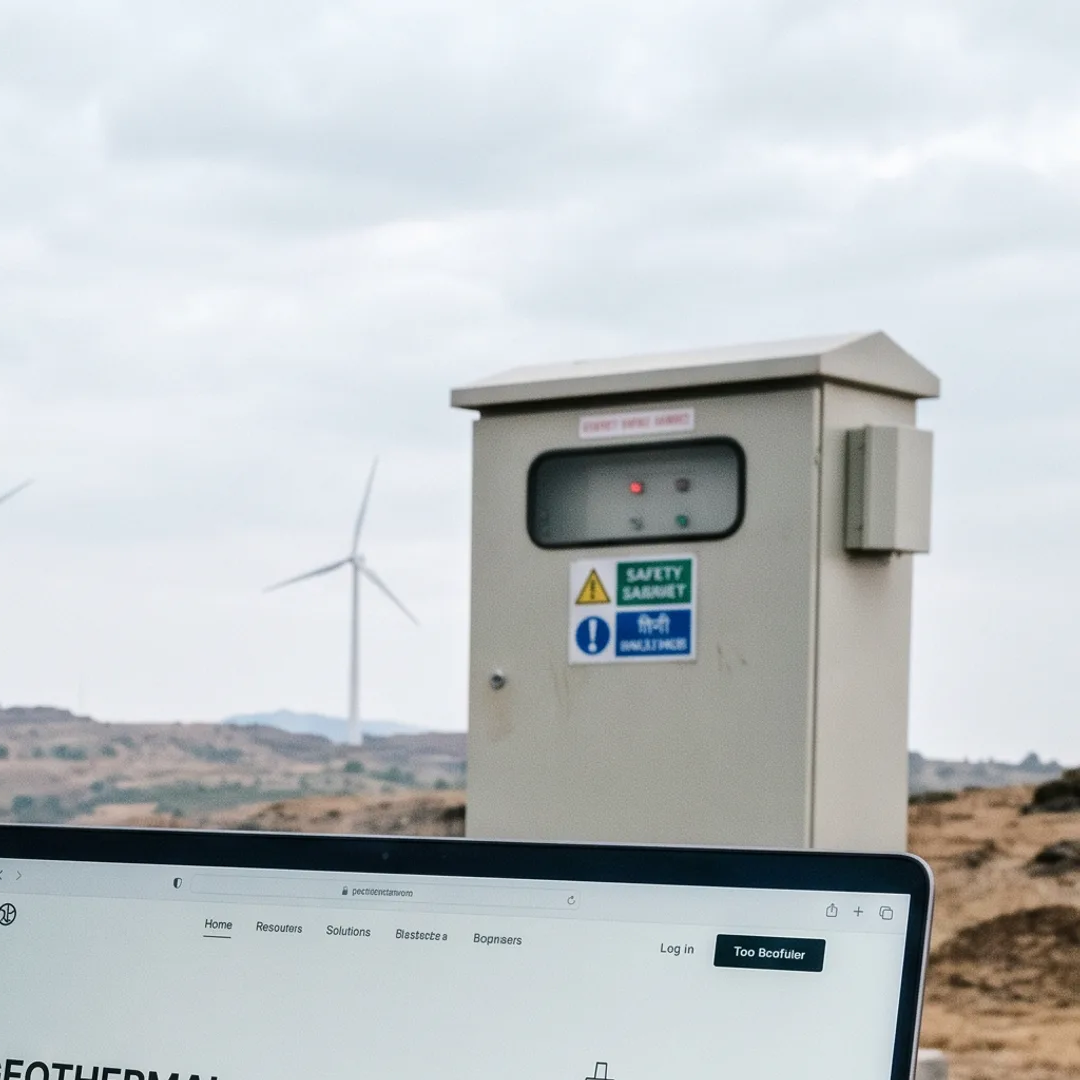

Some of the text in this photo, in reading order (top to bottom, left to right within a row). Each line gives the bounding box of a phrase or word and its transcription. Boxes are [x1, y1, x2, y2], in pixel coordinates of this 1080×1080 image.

[626, 565, 683, 583] SAFETY
[204, 918, 233, 931] Home
[326, 925, 371, 937] Solutions
[660, 943, 695, 956] Log in
[734, 946, 755, 957] Too
